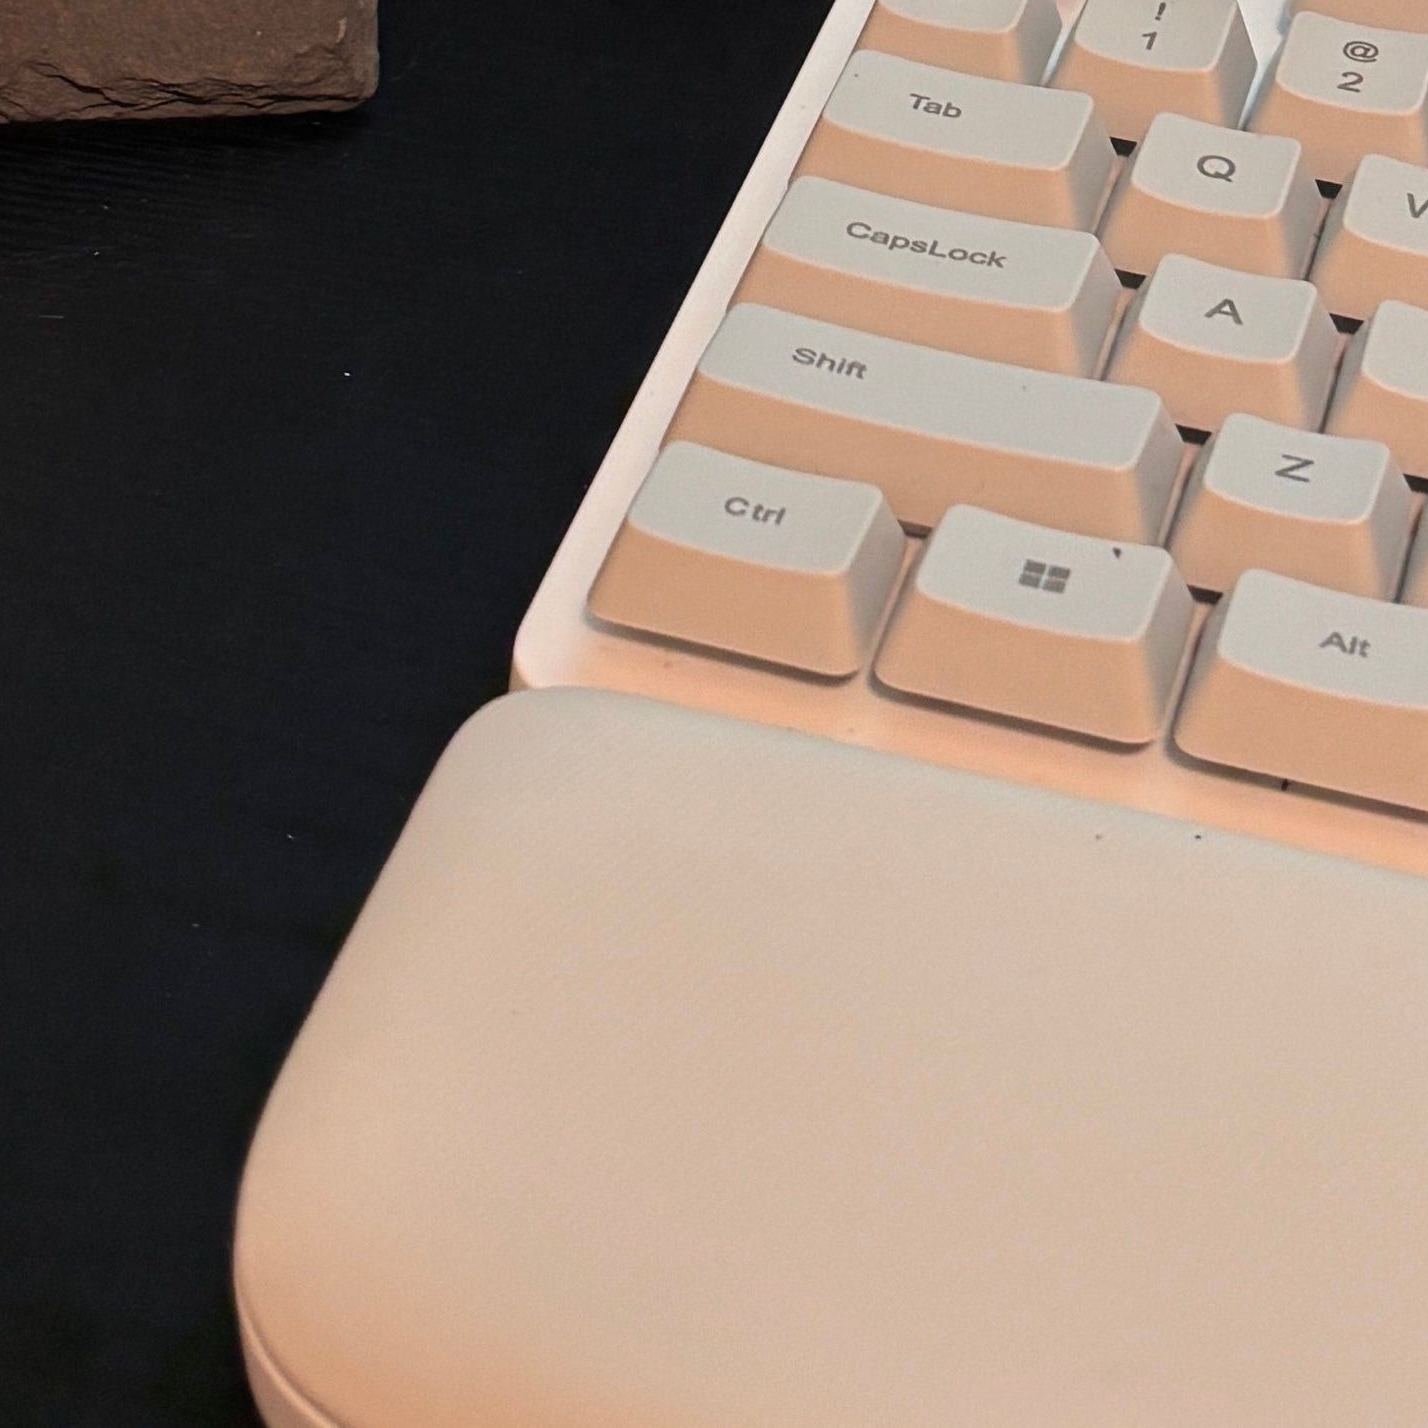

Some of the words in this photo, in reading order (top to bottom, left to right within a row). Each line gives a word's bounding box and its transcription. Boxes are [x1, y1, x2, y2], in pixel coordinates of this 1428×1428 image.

[1142, 31, 1158, 51] 1
[1337, 71, 1364, 94] 2
[910, 92, 962, 119] Tab
[1196, 154, 1236, 183] Q
[845, 219, 1008, 270] CapsLock
[1204, 298, 1243, 326] A
[791, 347, 867, 380] Shift
[1274, 454, 1315, 483] Z
[724, 496, 787, 526] Ctrl
[1319, 631, 1371, 658] Alt
